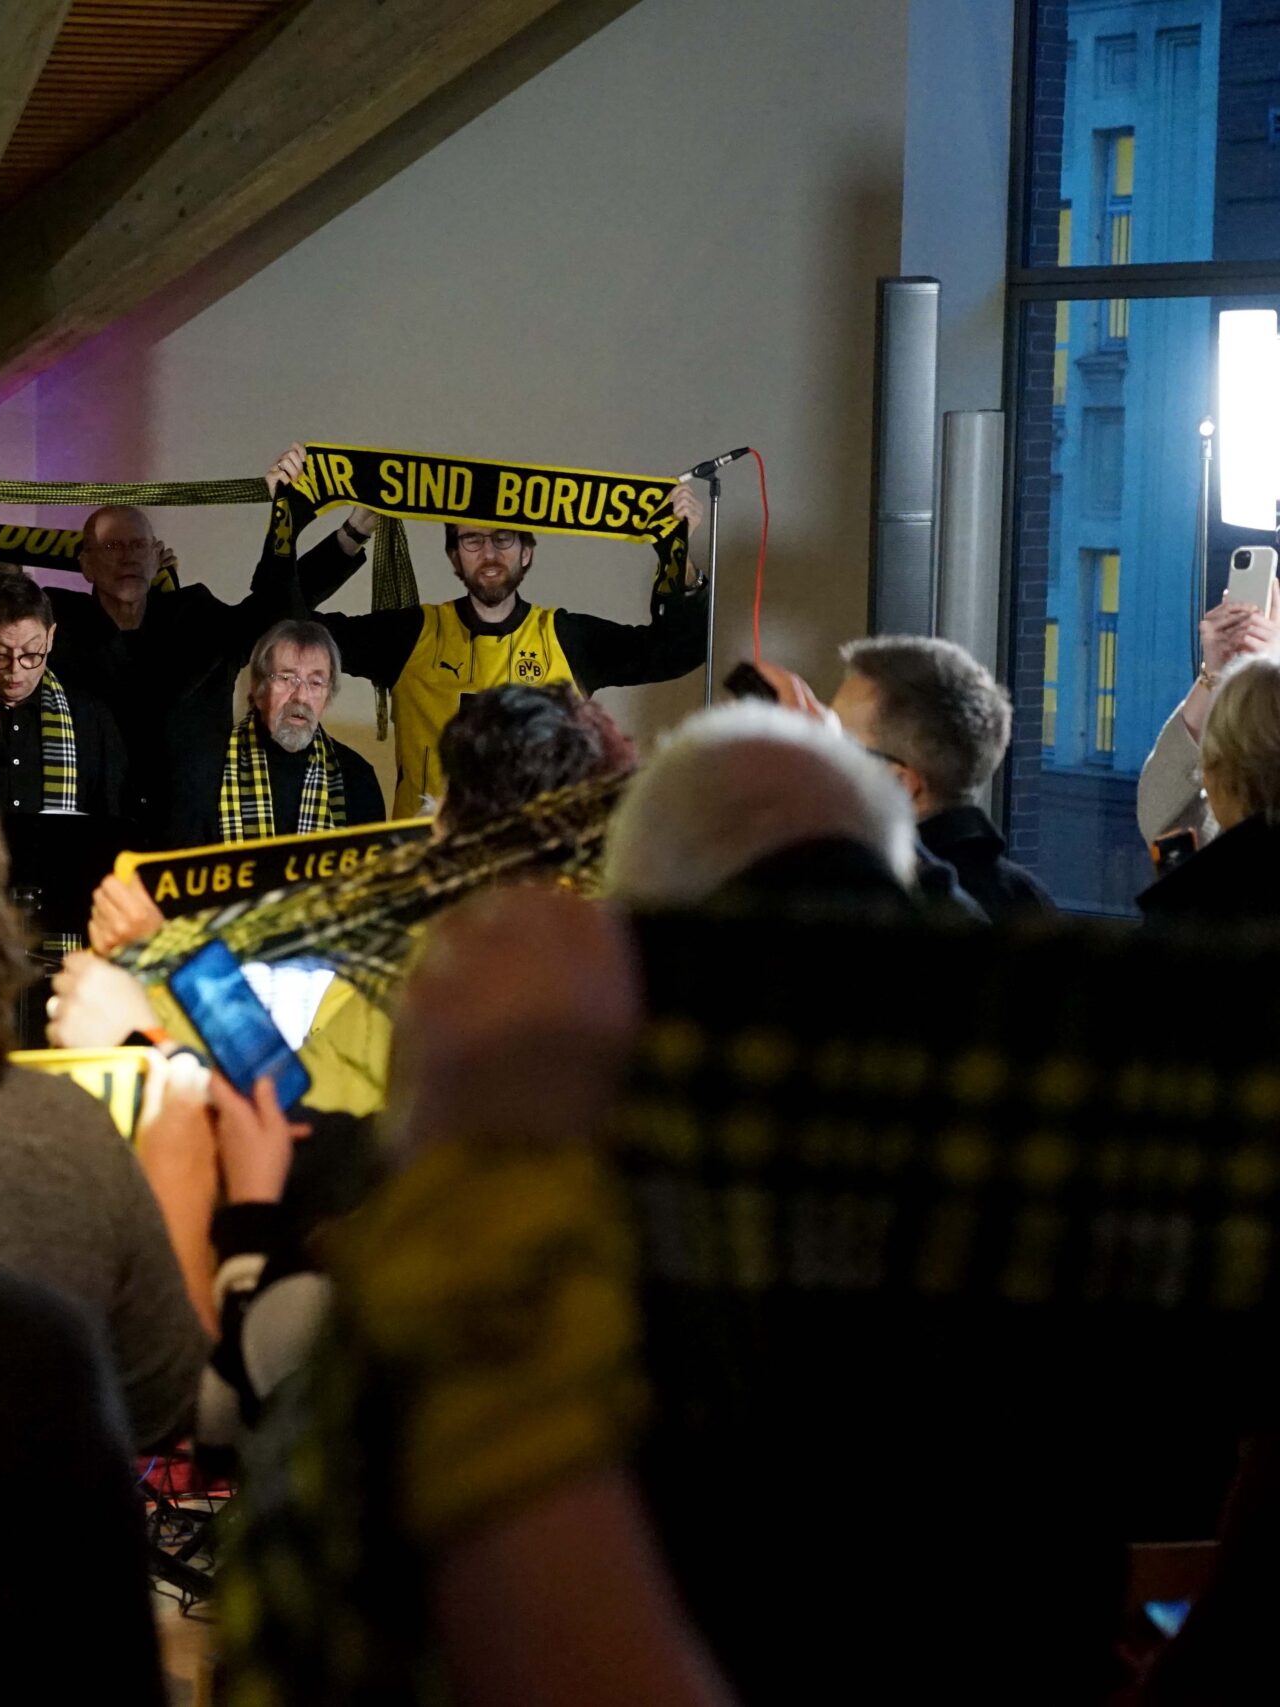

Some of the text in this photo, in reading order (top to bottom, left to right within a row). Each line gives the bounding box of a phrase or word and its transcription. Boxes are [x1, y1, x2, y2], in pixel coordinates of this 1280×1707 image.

[290, 453, 358, 504] WIR
[379, 459, 473, 511] SIND
[519, 660, 541, 677] BVB
[154, 860, 257, 902] AUBE
